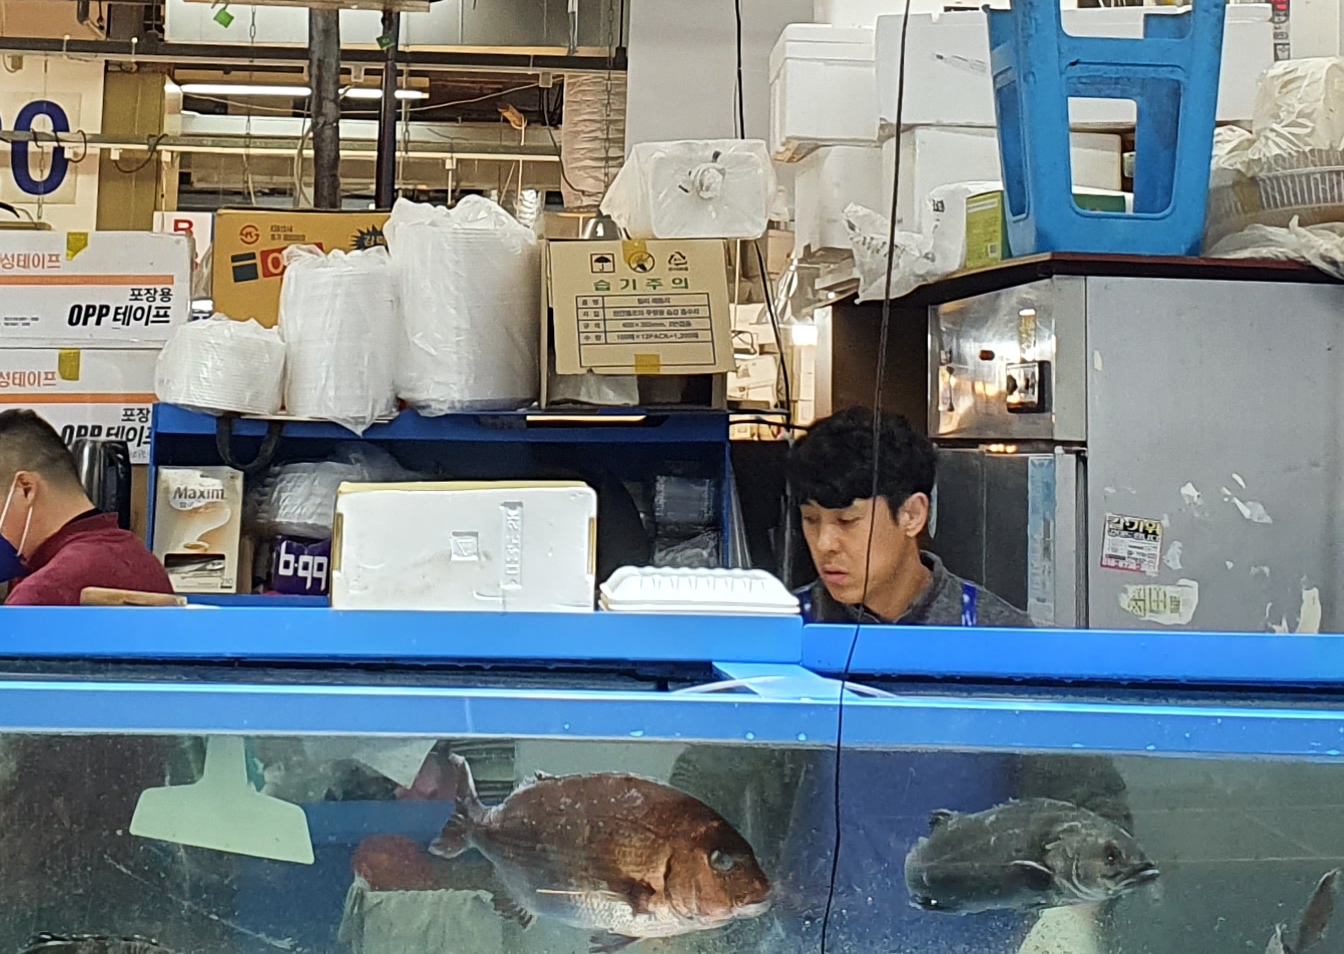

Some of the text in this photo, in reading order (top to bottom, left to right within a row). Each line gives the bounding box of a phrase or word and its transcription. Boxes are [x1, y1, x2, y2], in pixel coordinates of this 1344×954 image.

[128, 286, 174, 303] 포장용
[67, 303, 112, 327] OPP
[112, 305, 172, 327] 테이프
[172, 486, 228, 501] Maxim
